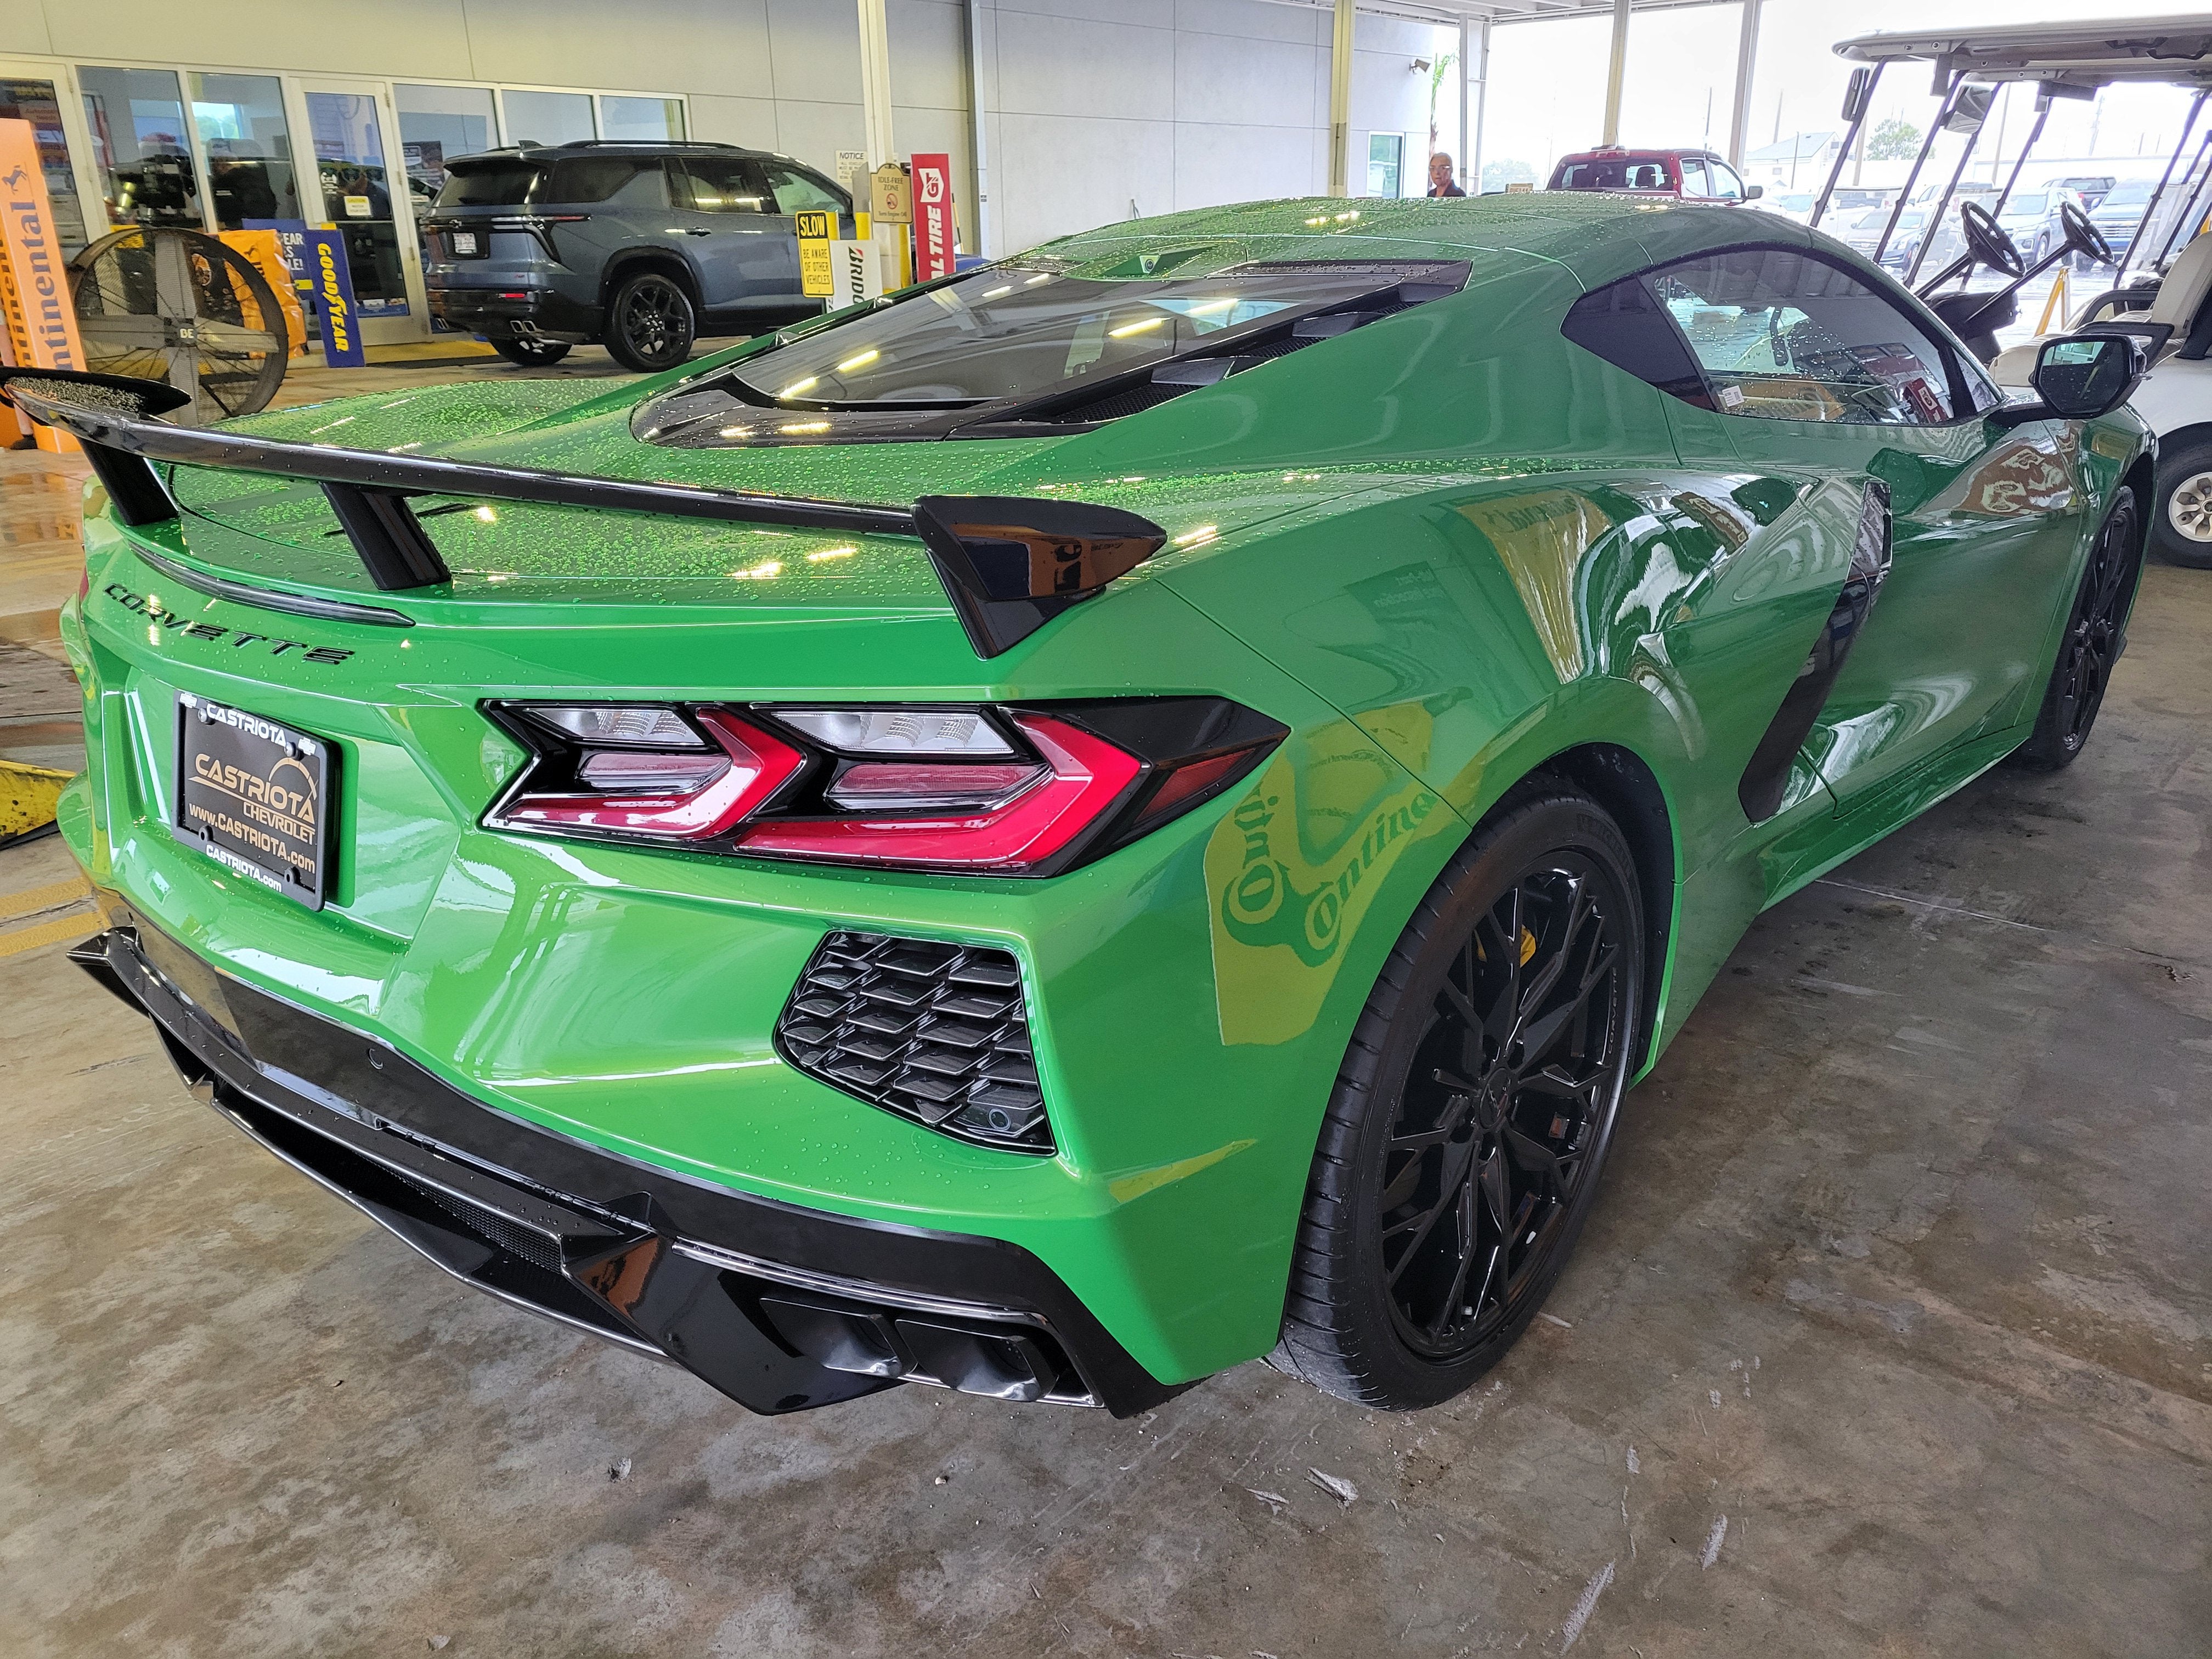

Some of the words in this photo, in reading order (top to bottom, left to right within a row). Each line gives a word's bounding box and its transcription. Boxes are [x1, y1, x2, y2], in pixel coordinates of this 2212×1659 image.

[800, 216, 825, 237] SLOW
[927, 205, 944, 255] TIRE
[803, 249, 810, 259] BE
[812, 249, 828, 259] AWARE
[804, 262, 811, 272] OF
[812, 262, 829, 272] OTHER
[318, 242, 349, 352] GOODYEAR
[806, 274, 831, 285] VEHICLES
[103, 583, 356, 665] CORVETTE
[206, 703, 287, 747] CASTRIOTA
[195, 753, 315, 825] CASTRIOTA
[188, 803, 315, 874] www.CASTRIOTA.com
[242, 801, 316, 845] CHEVROLET
[205, 844, 283, 893] CASTRIOTA.com
[1608, 967, 1618, 1054] CORVETTE
